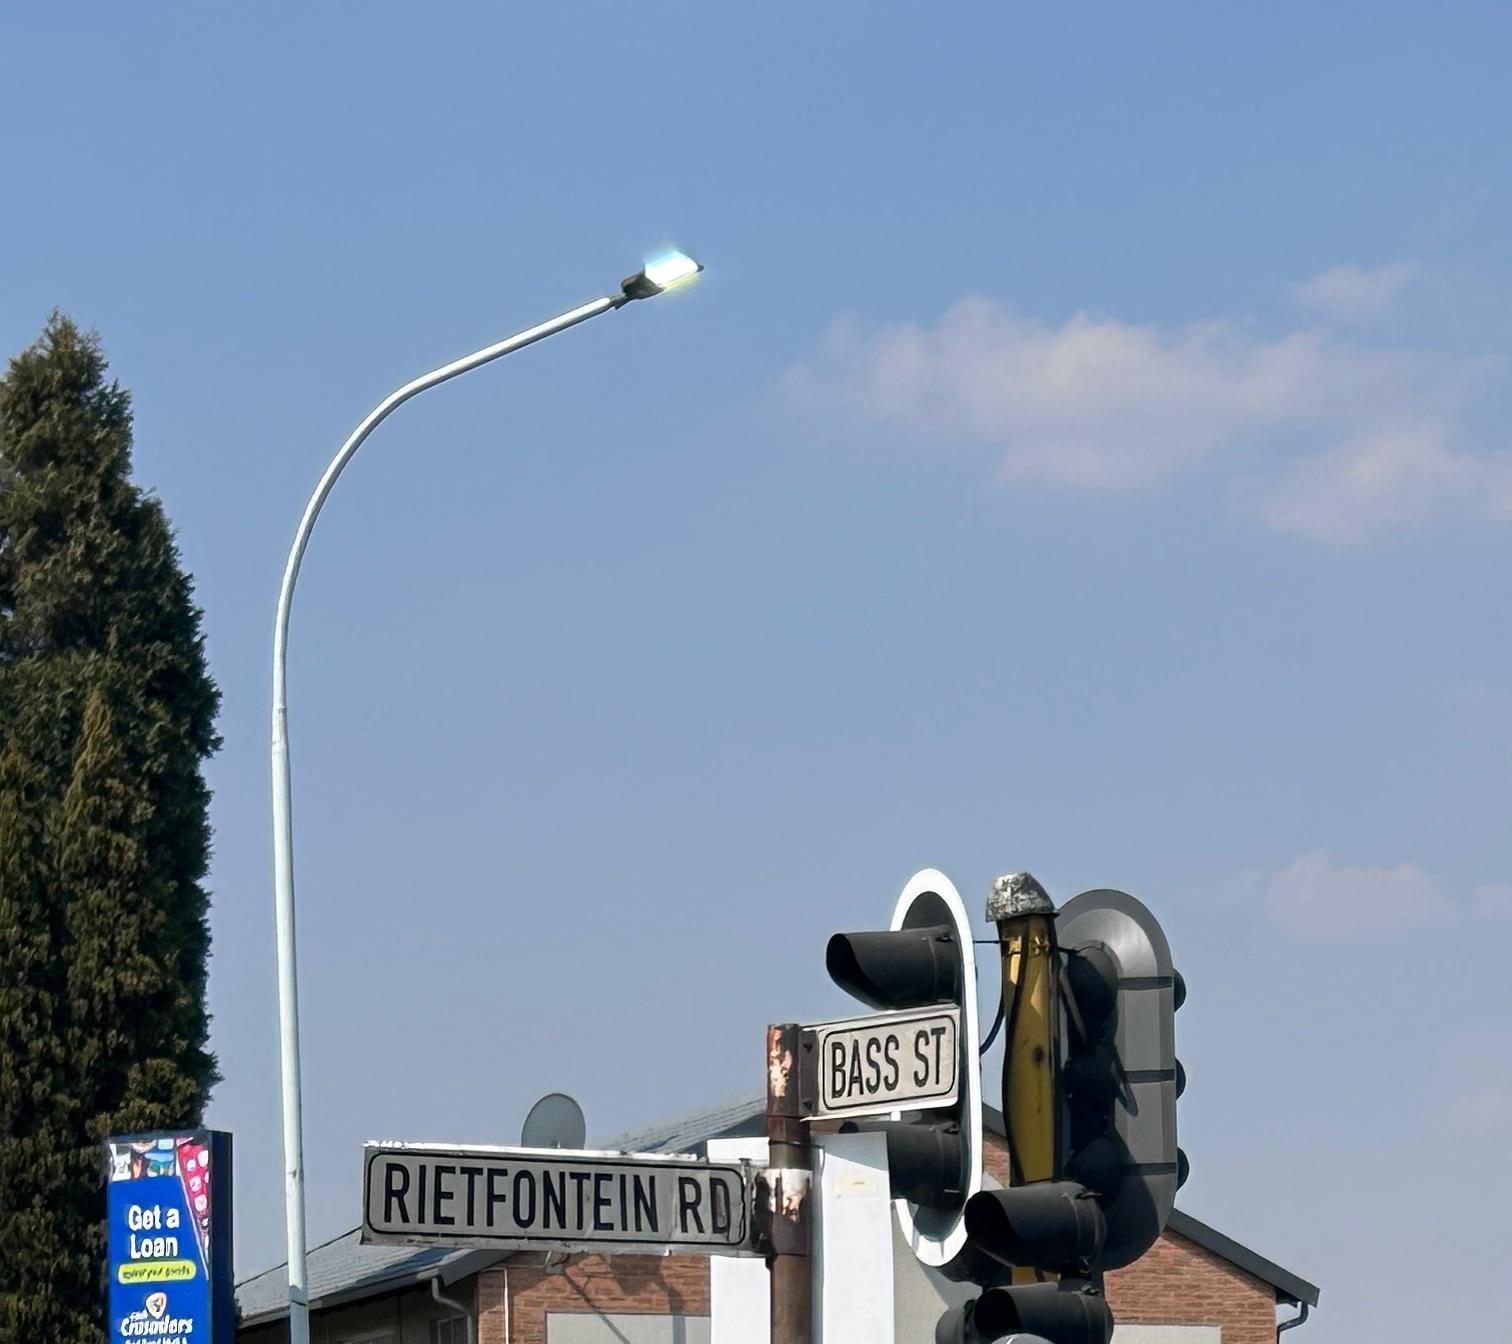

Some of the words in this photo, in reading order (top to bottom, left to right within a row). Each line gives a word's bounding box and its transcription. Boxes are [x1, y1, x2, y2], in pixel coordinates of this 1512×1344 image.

[831, 1034, 900, 1099] BASS
[913, 1026, 946, 1088] ST
[166, 1207, 180, 1229] a
[383, 1162, 659, 1233] RIETFONTEIN
[677, 1176, 732, 1235] RD
[130, 1233, 178, 1259] Loan
